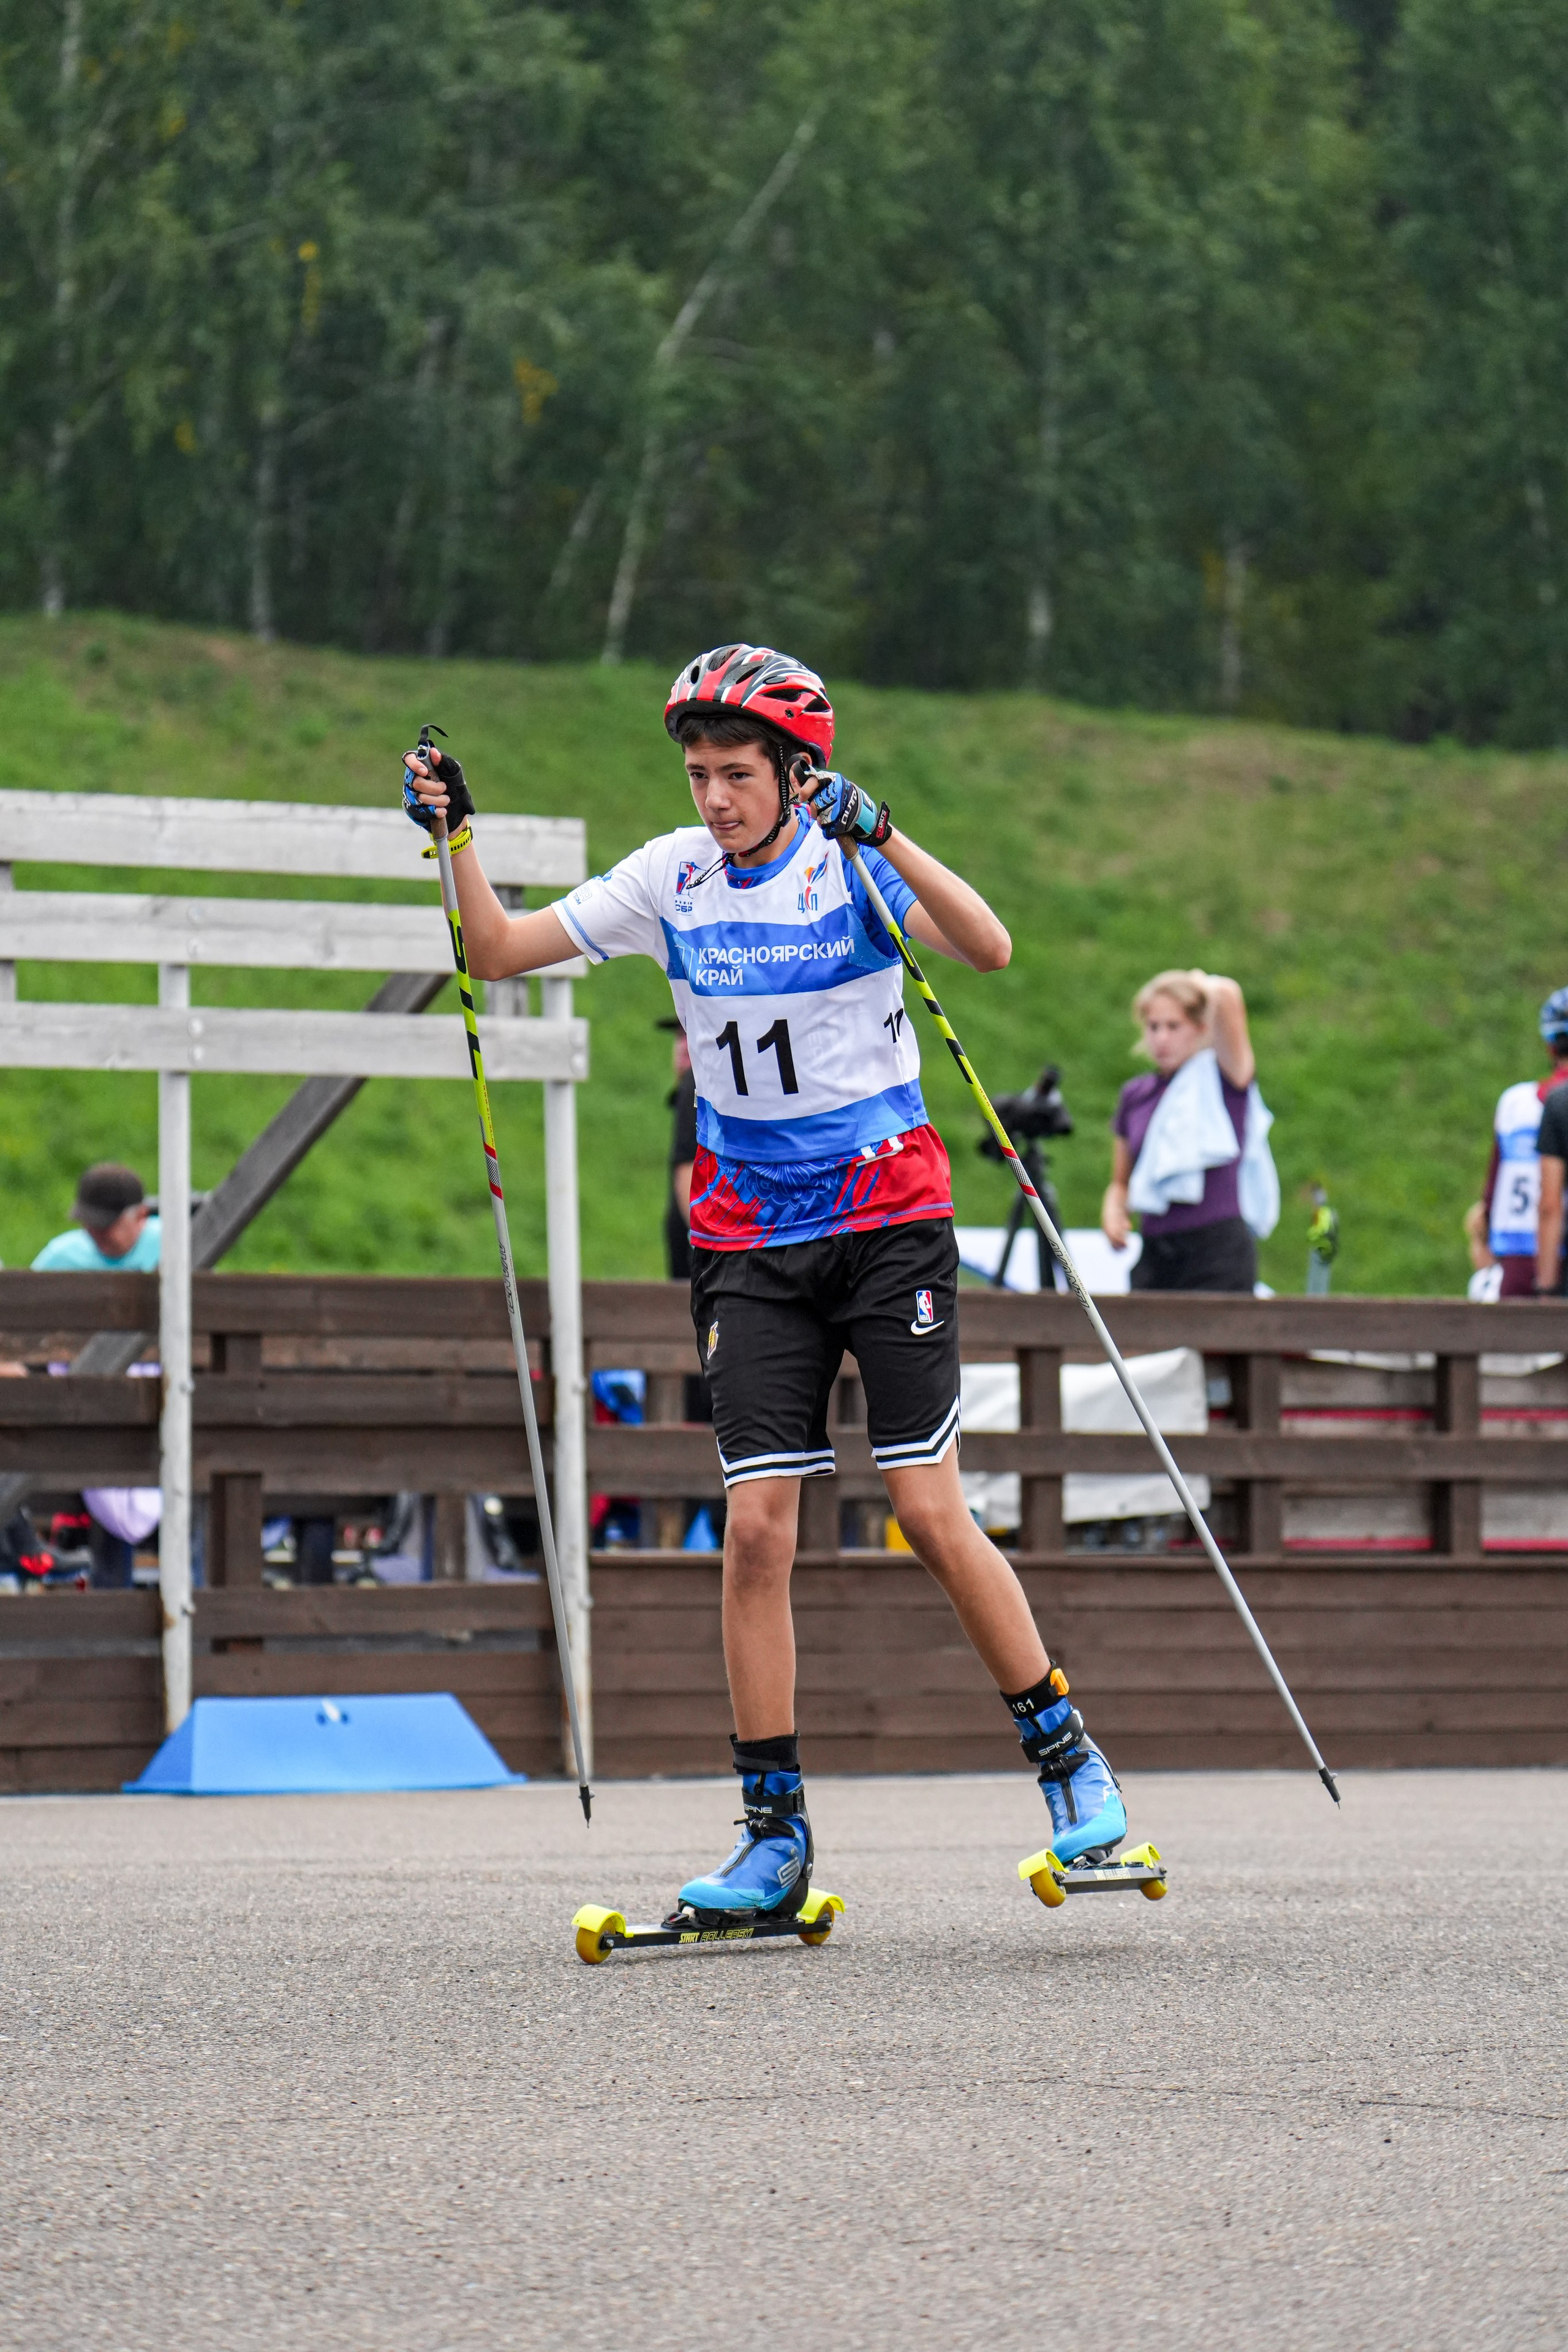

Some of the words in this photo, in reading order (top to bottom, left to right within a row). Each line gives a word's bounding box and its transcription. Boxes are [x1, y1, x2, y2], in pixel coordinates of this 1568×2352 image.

[675, 904, 693, 913] СБР
[698, 935, 855, 964] КРАСНОЯРСКИЙ
[695, 965, 744, 986] КРАЙ
[715, 1019, 799, 1096] 11
[1510, 1175, 1530, 1216] 5
[1012, 1698, 1034, 1714] 161
[1038, 1732, 1072, 1756] SPINE
[744, 1804, 772, 1814] SPINE
[679, 1932, 699, 1943] START
[699, 1928, 754, 1942] ROLLERSKI
